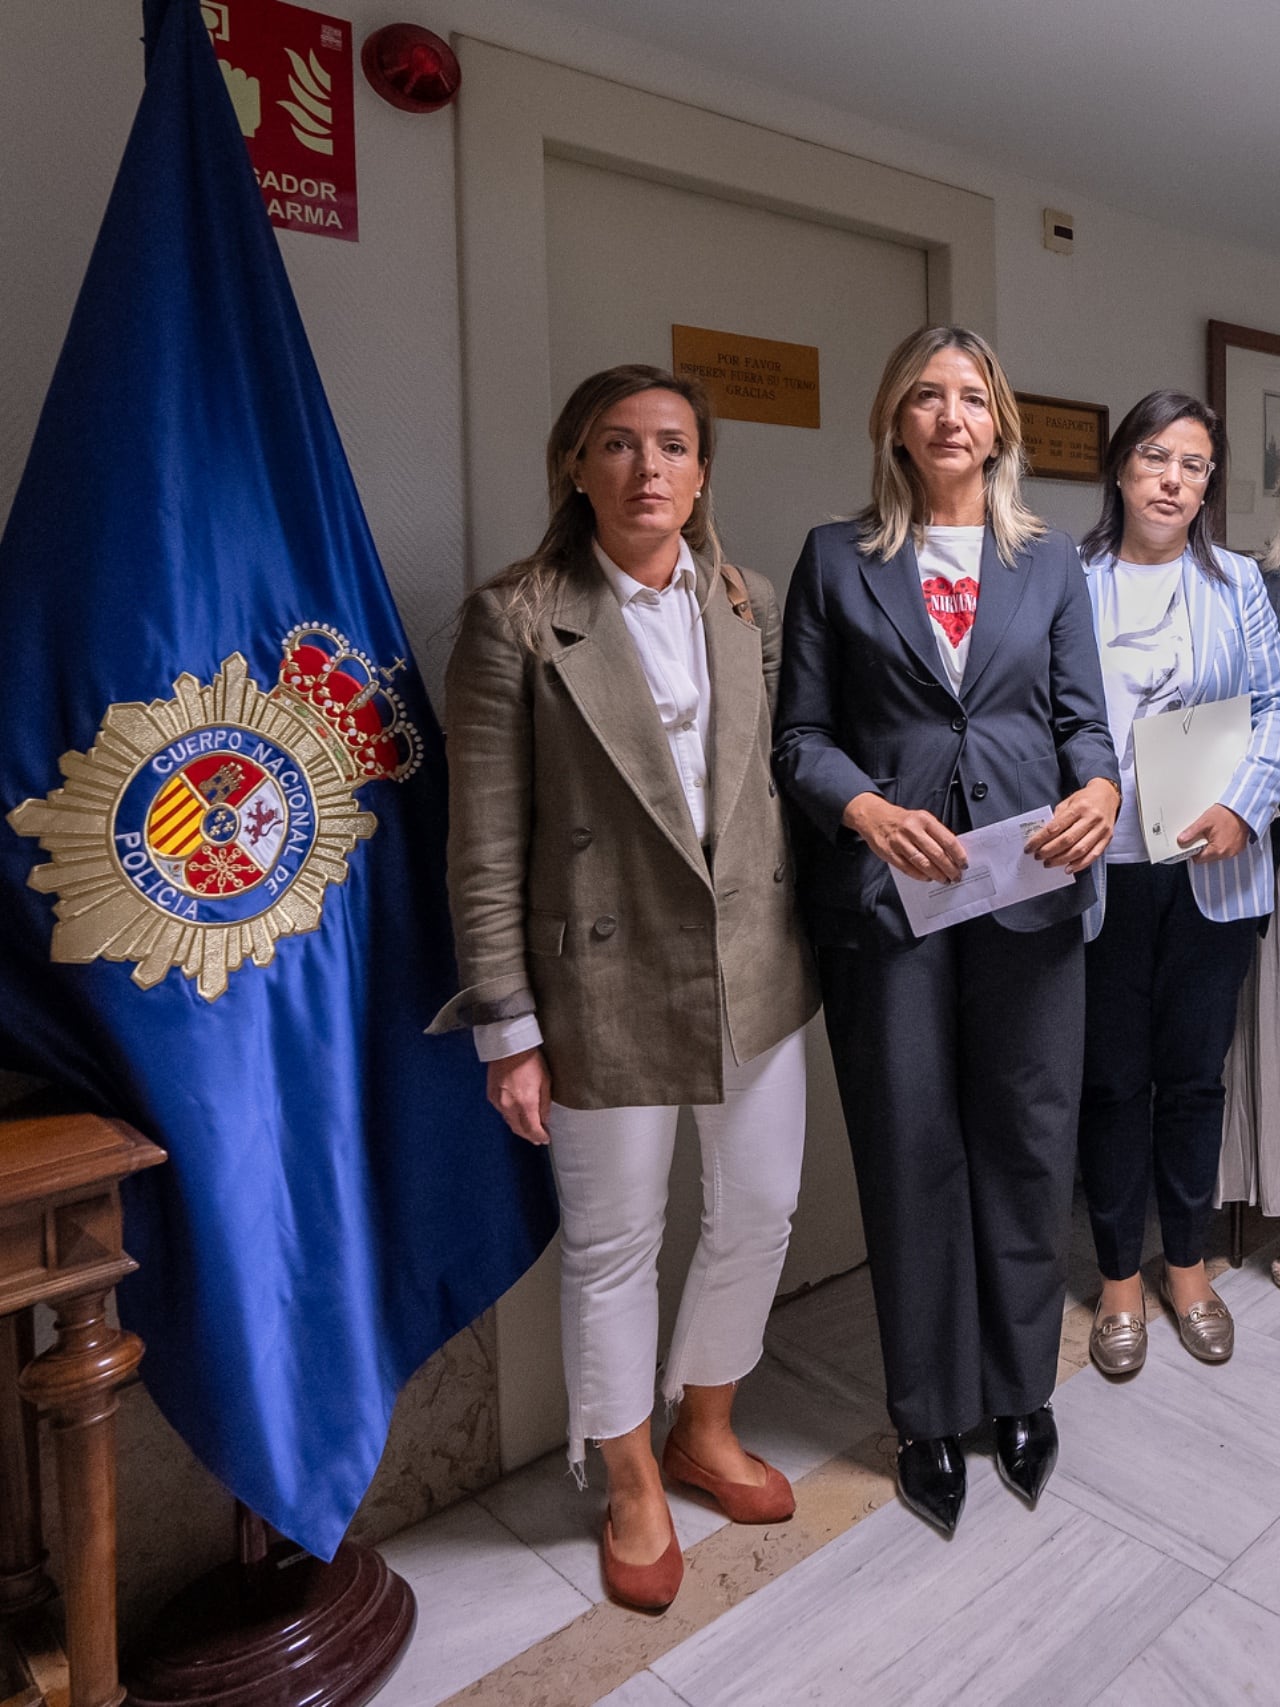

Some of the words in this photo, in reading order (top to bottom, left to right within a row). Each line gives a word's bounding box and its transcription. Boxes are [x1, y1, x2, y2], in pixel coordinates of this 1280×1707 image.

[267, 198, 343, 230] ARMA
[717, 352, 740, 366] POR
[745, 357, 781, 371] FAVOR
[726, 384, 776, 400] GRACIAS
[152, 730, 243, 774] CUERPO
[251, 742, 311, 858] NACIONAL
[115, 831, 200, 921] POLICIA
[264, 865, 290, 896] DE
